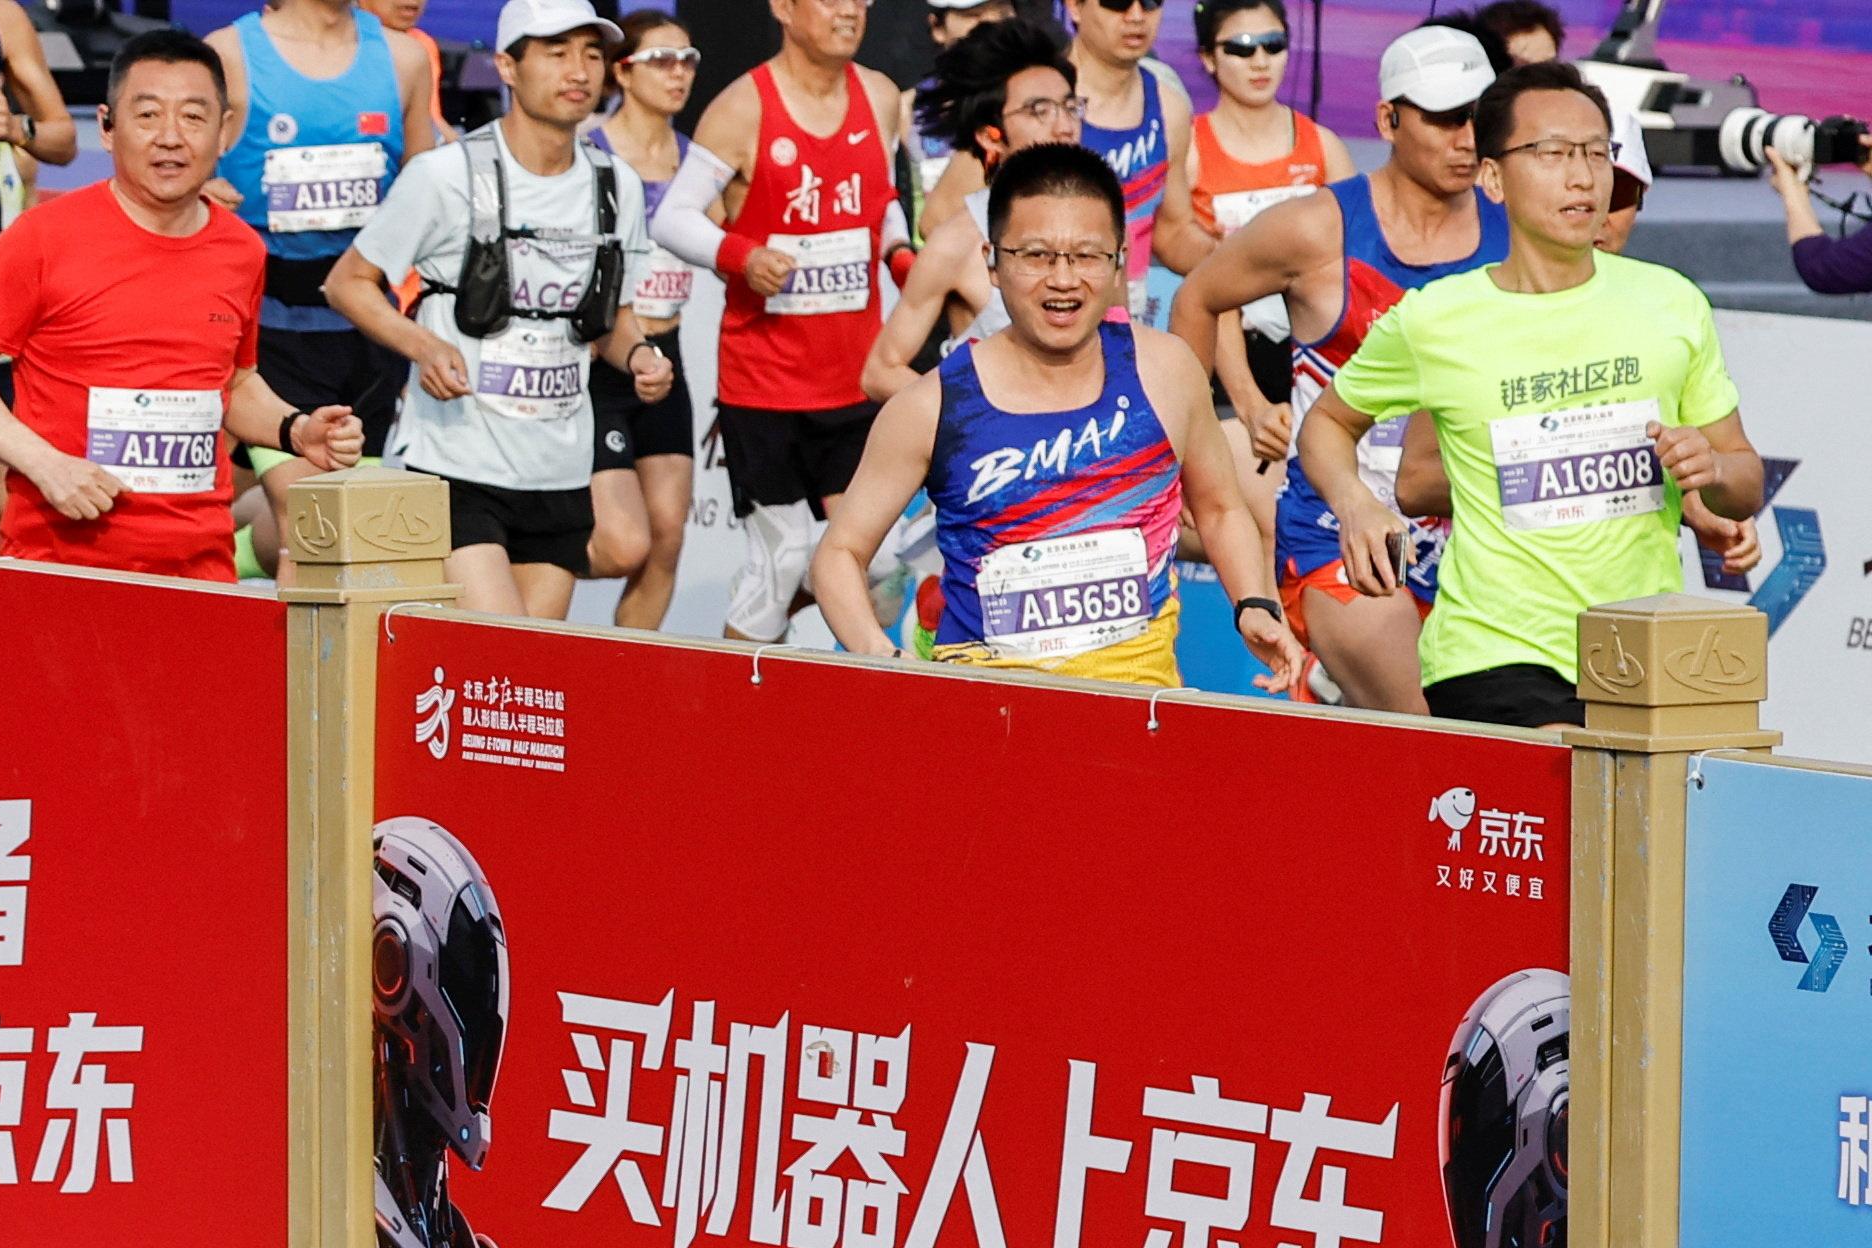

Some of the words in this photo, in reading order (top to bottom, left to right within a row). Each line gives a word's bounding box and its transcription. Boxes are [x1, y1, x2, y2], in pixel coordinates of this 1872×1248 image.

[295, 179, 378, 209] A11568
[791, 263, 868, 293] A16335
[1500, 355, 1643, 412] 链家社区跑
[121, 433, 215, 466] A17768
[1539, 449, 1654, 498] A16608
[1022, 579, 1142, 630] A15658
[1479, 808, 1545, 862] 京东
[1436, 864, 1544, 900] 又好又便宜
